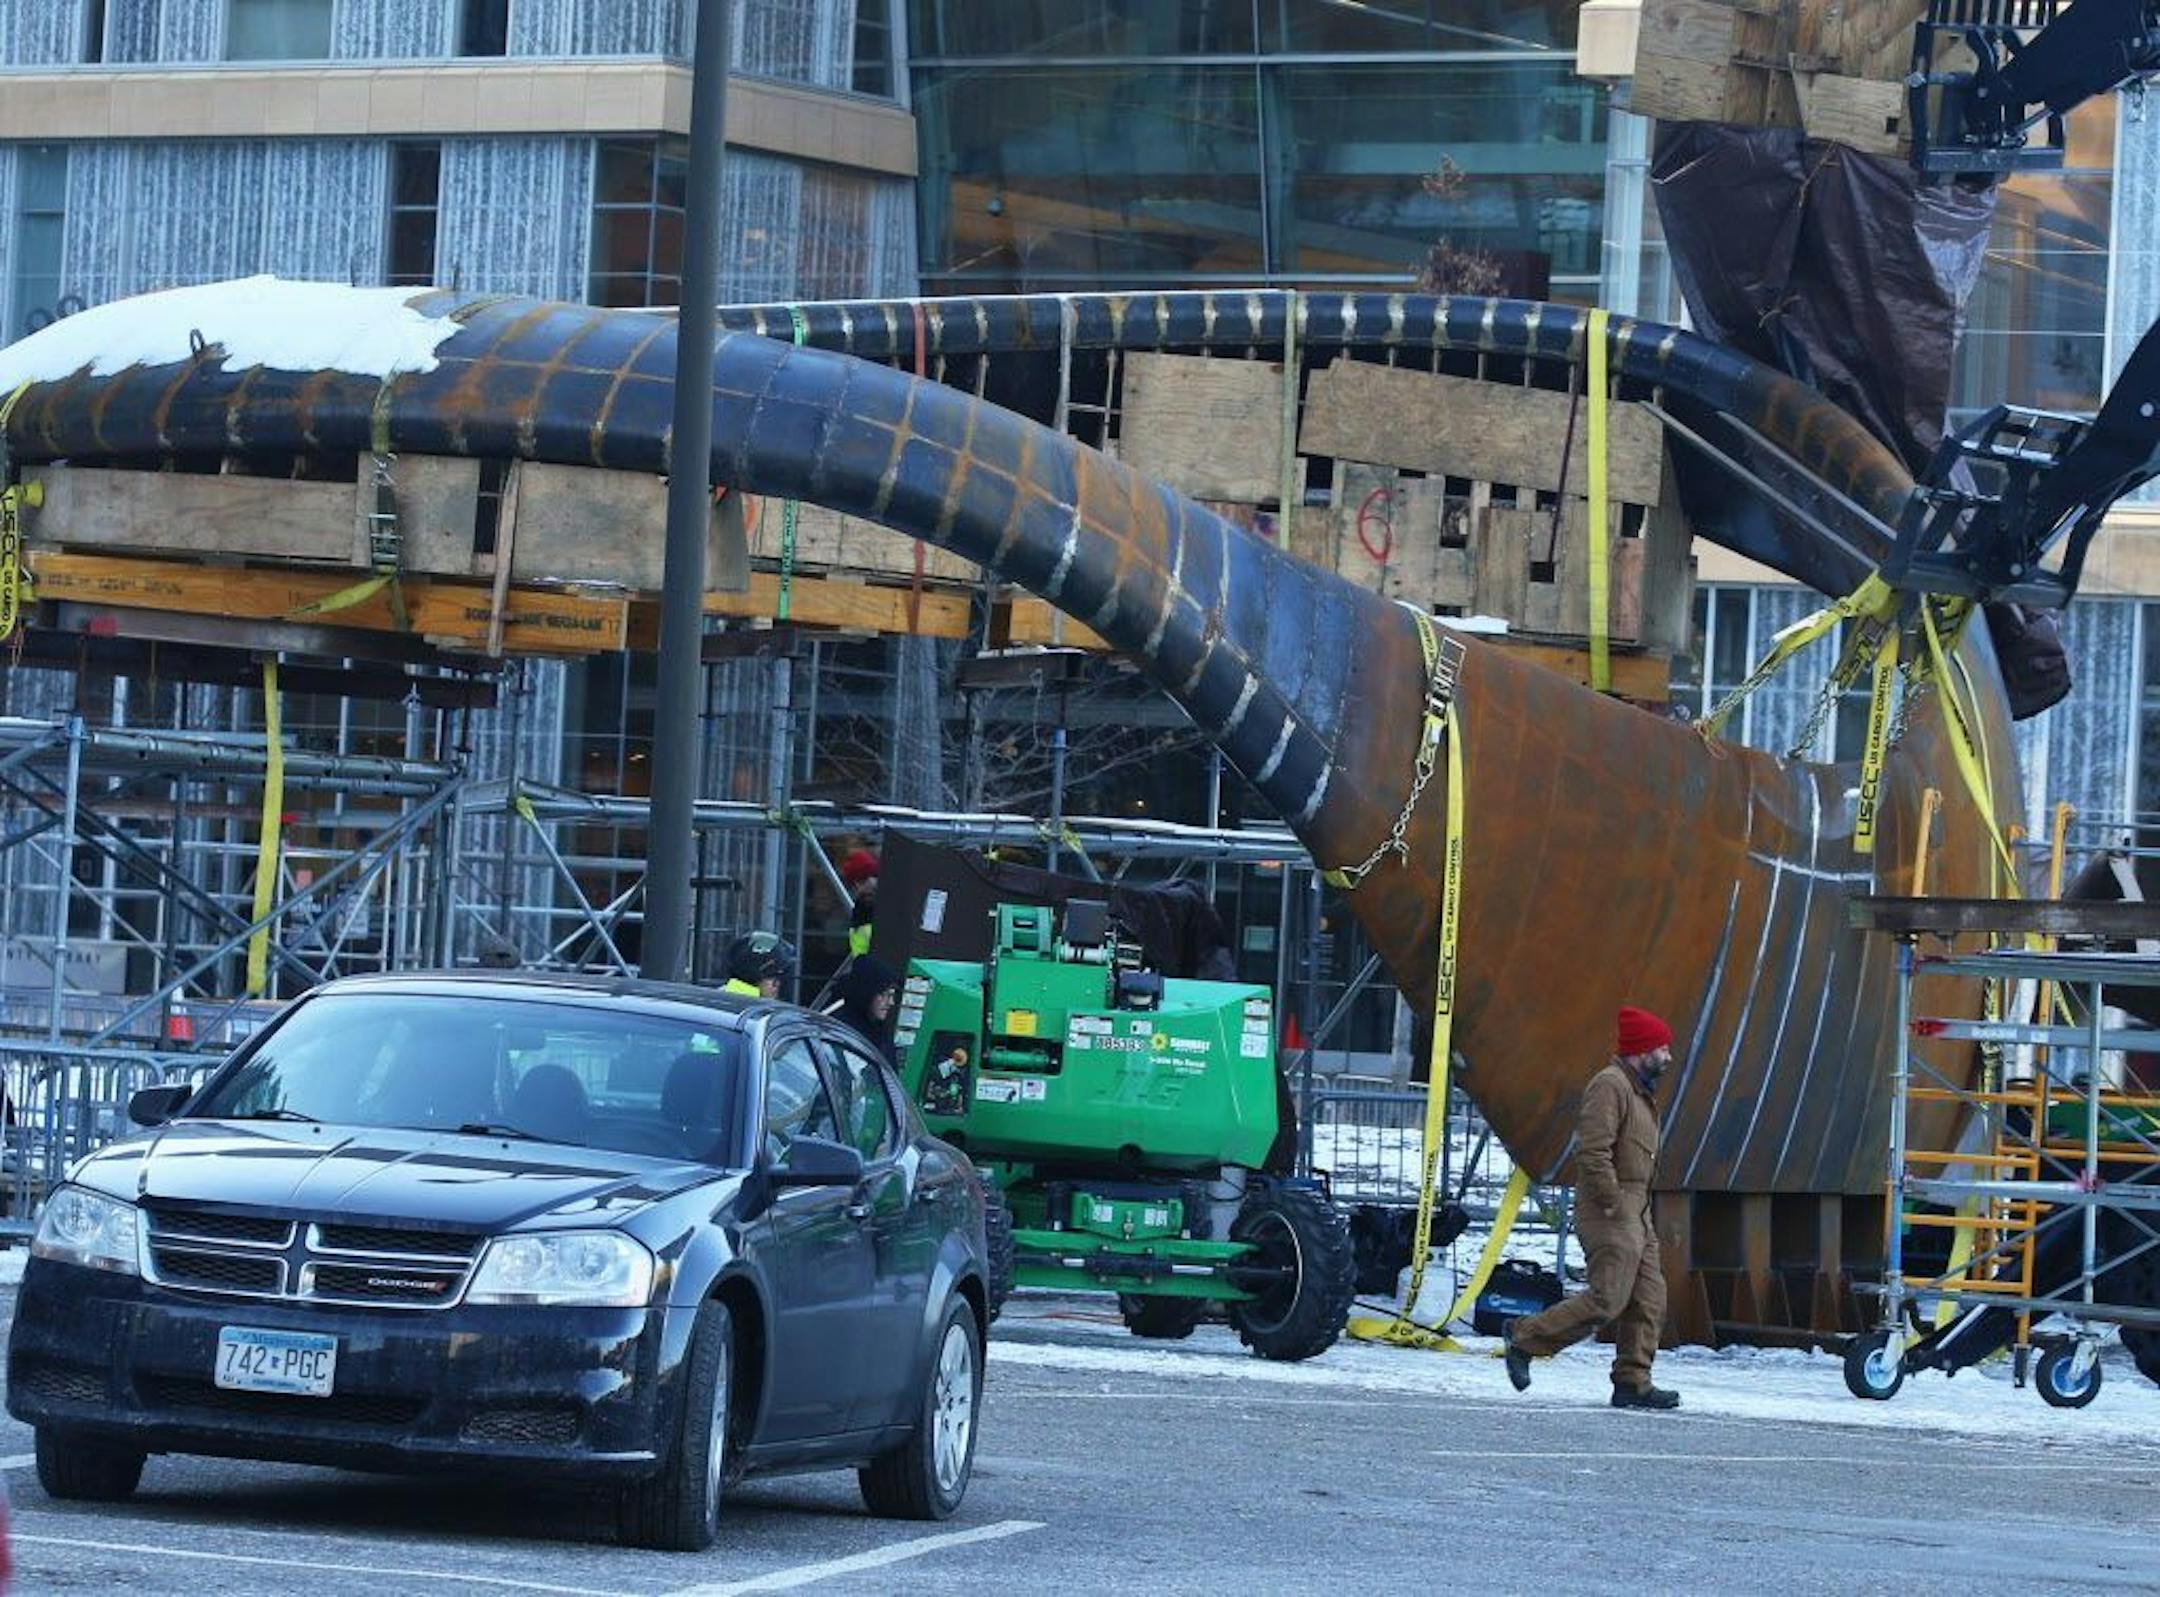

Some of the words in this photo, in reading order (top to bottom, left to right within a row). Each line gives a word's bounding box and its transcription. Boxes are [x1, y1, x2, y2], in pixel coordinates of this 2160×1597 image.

[1358, 486, 1393, 563] 6
[1876, 664, 1891, 713] CONTROL
[1871, 713, 1885, 751] CARGO
[1448, 836, 1459, 885] CONTROL
[1446, 887, 1456, 924] CARGO
[224, 1343, 268, 1376] 742
[283, 1348, 329, 1381] PGC
